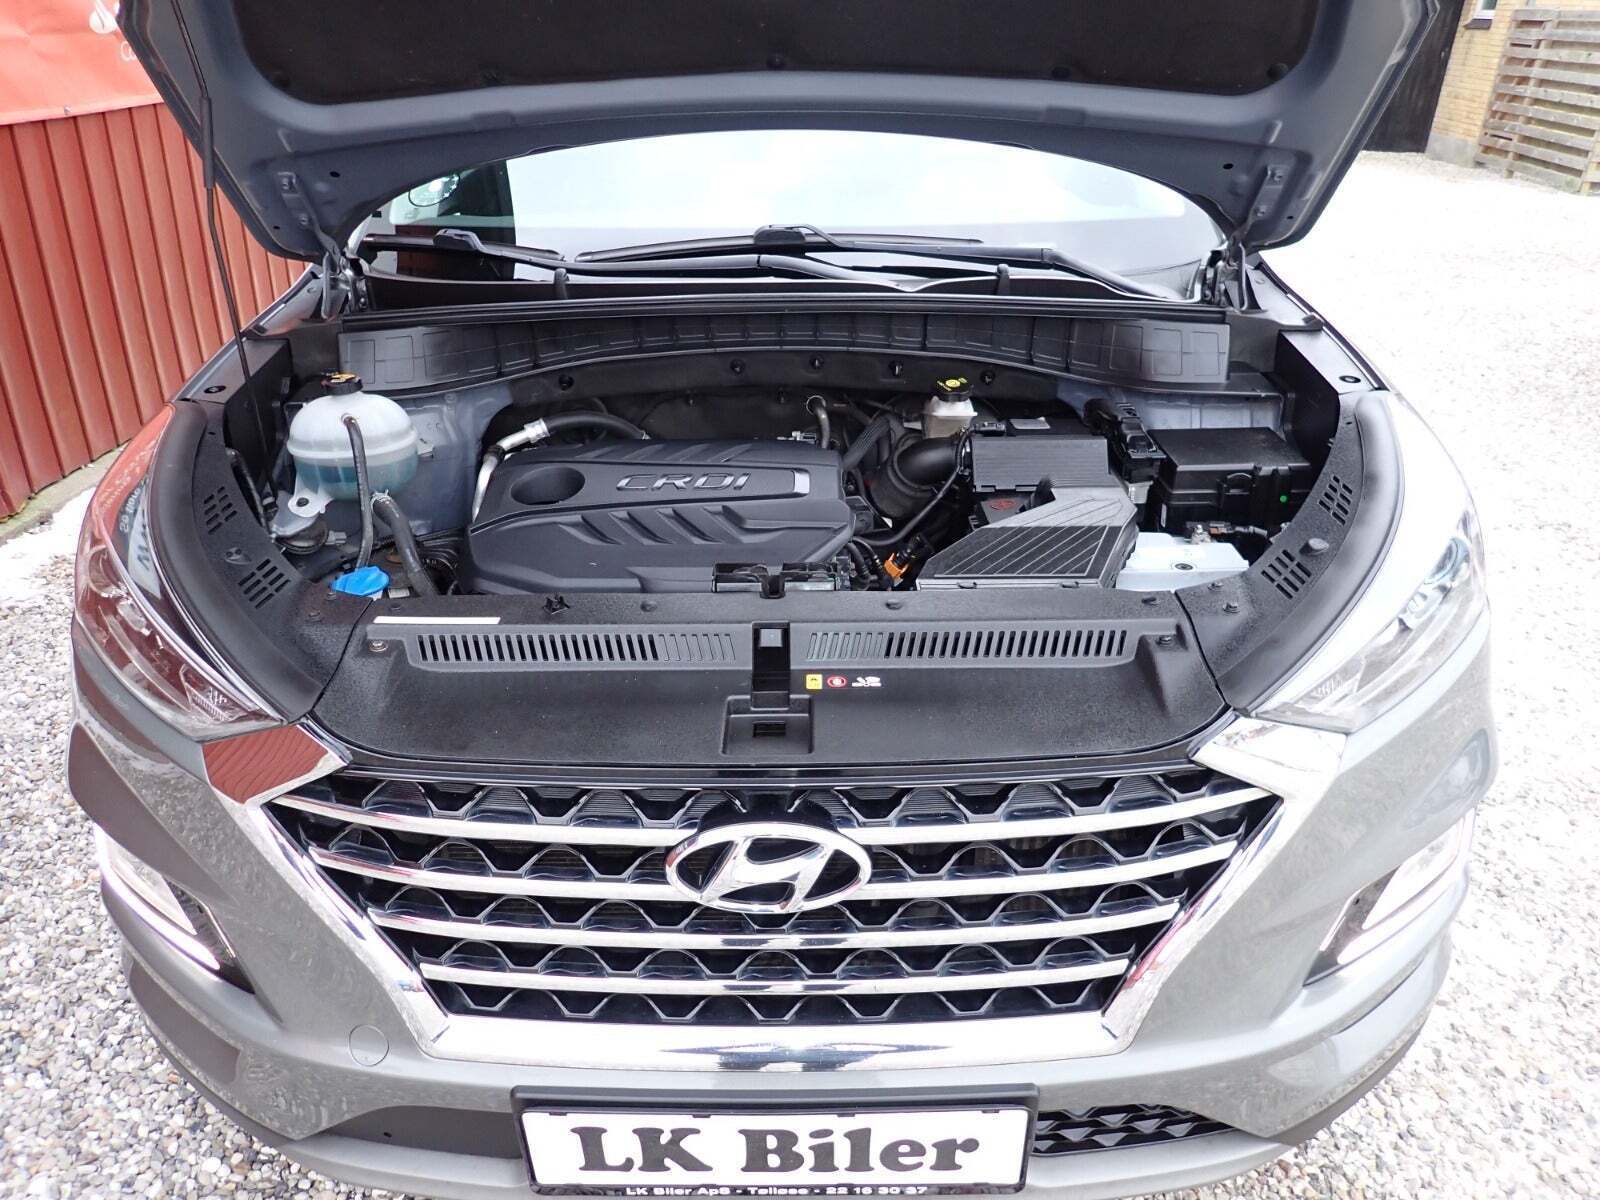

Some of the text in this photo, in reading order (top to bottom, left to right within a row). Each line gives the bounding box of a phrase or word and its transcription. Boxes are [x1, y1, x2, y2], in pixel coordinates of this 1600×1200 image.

[616, 473, 751, 490] CRDI
[570, 1127, 980, 1172] LK Biler
[626, 1187, 648, 1196] LK
[653, 1187, 692, 1196] Biler
[697, 1187, 731, 1196] ApS
[826, 1186, 849, 1195] 22
[878, 1186, 901, 1195] 30
